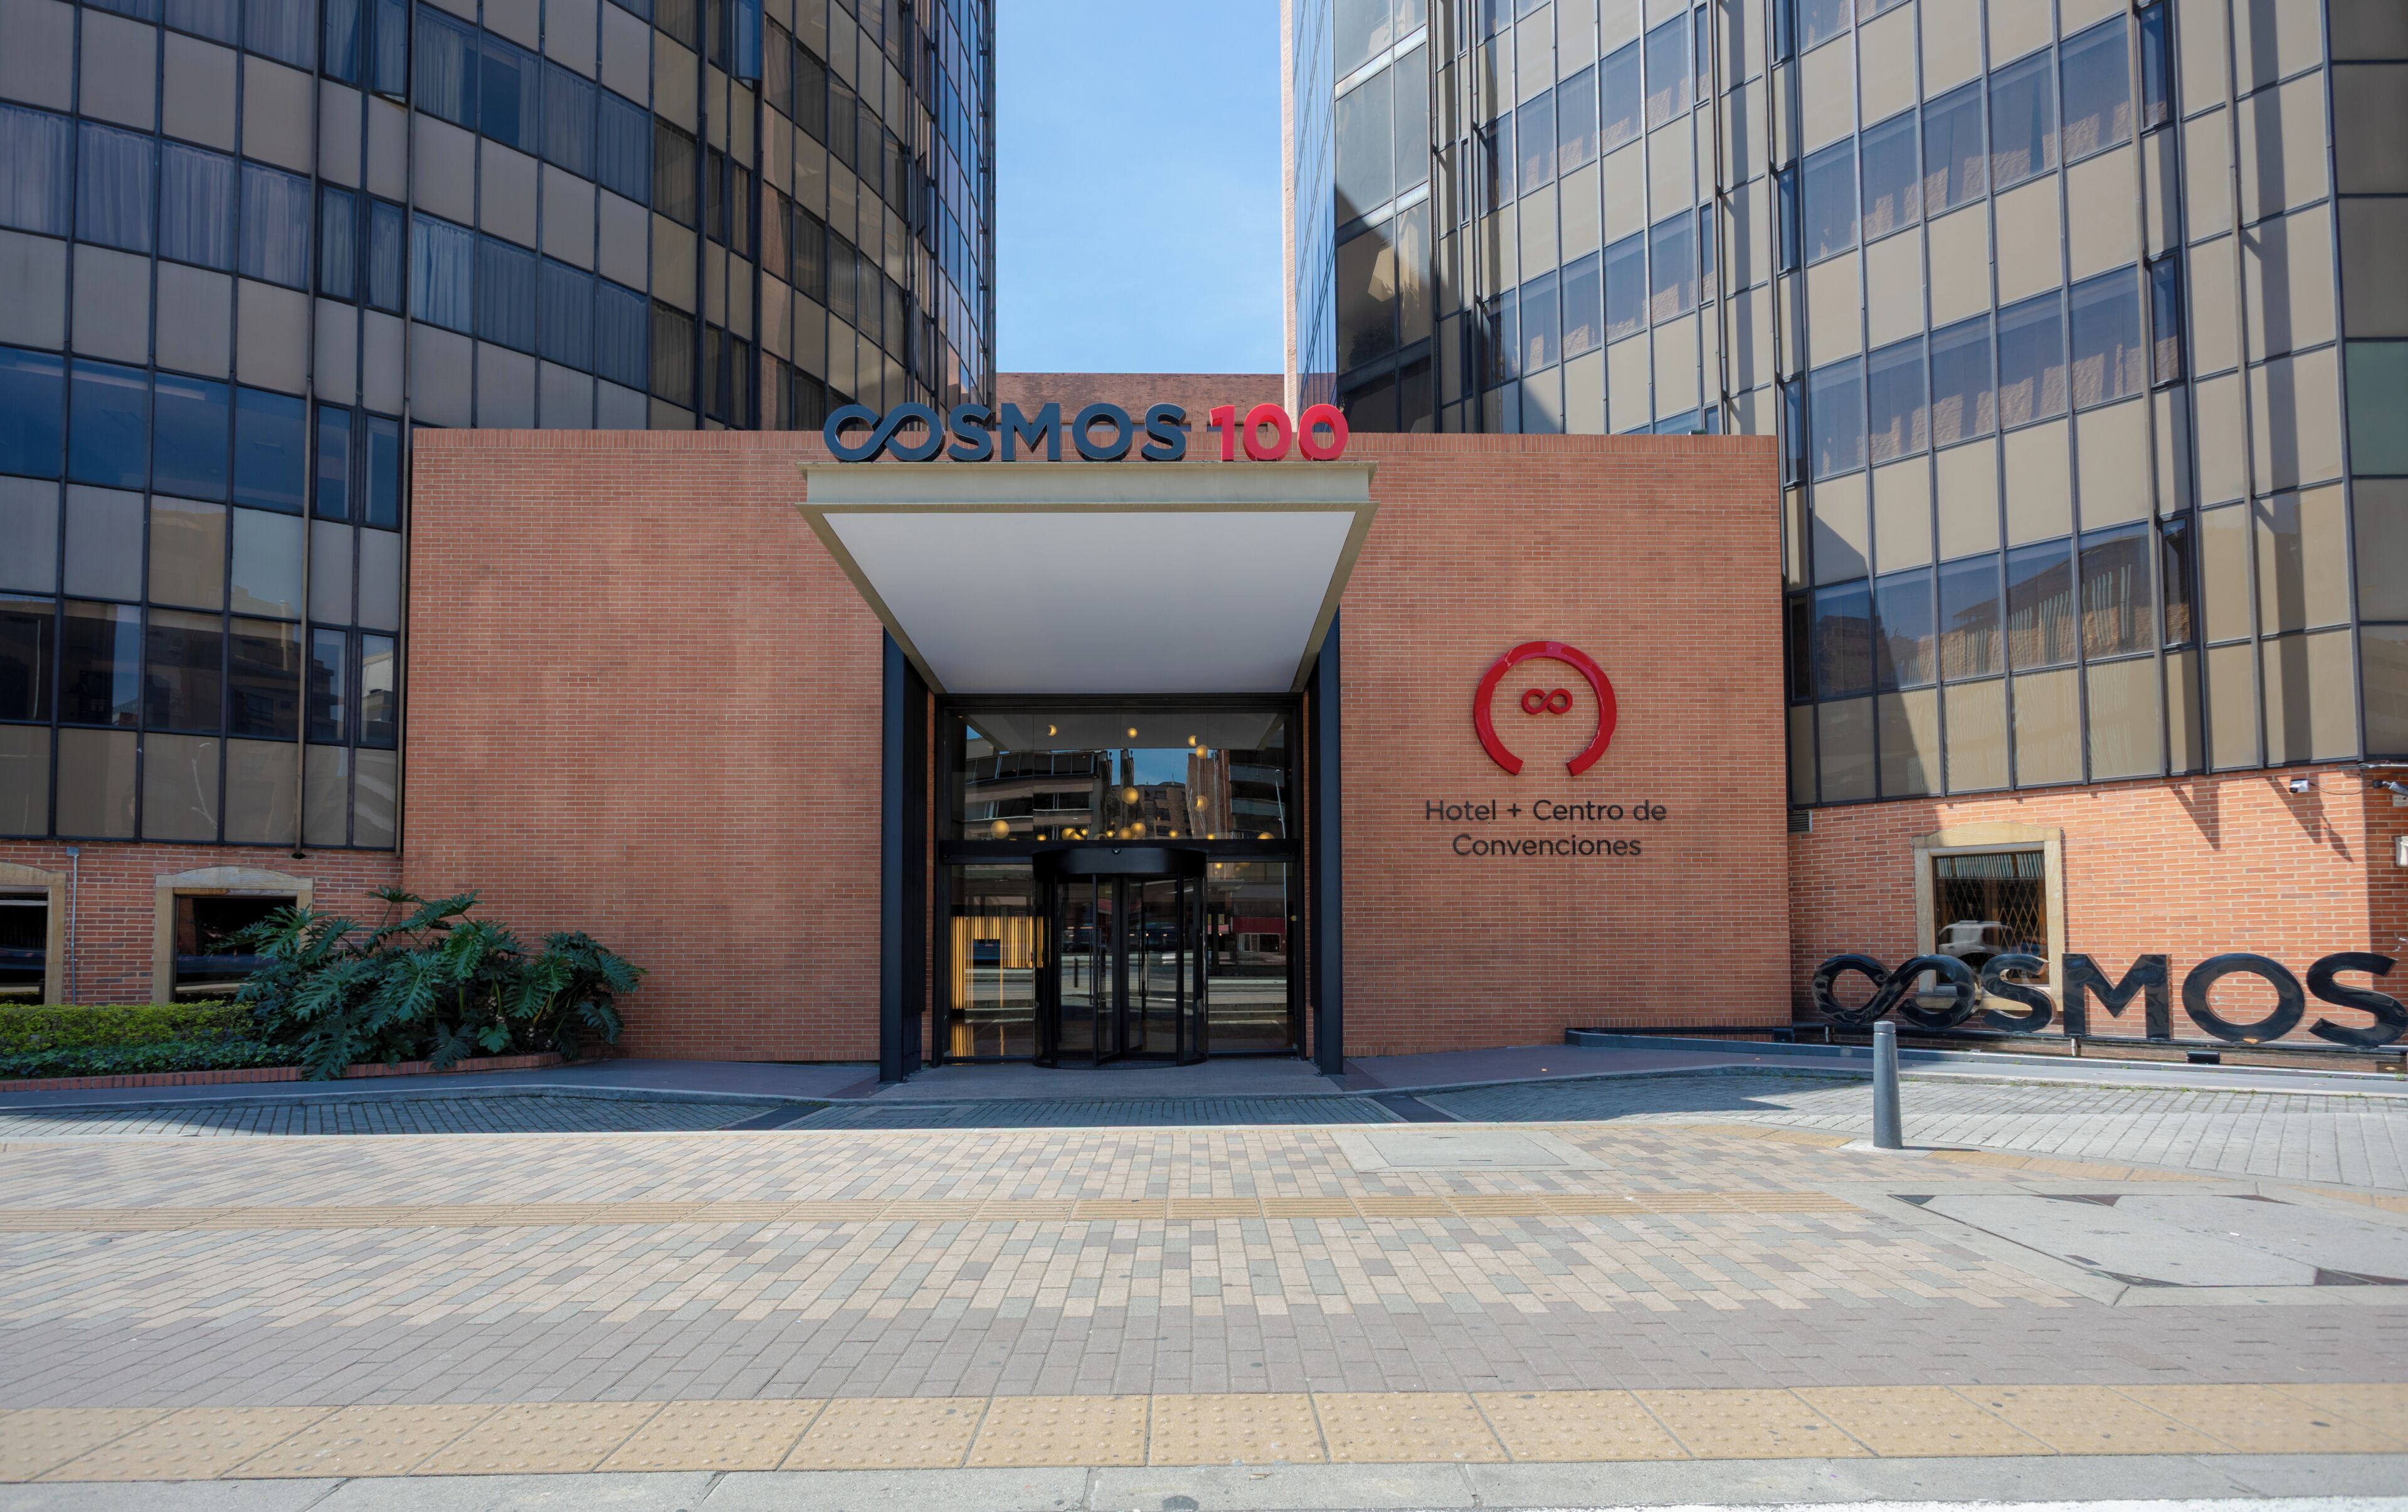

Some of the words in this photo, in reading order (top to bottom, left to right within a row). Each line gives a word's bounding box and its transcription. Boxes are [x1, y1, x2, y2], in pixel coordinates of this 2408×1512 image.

[823, 402, 1187, 462] COSMOS
[1209, 403, 1349, 462] 100
[1426, 800, 1496, 821] Hotel
[1533, 800, 1624, 821] Centro
[1634, 800, 1667, 821] de
[1453, 834, 1642, 855] Convenciones
[1812, 952, 2408, 1047] COSMOS
